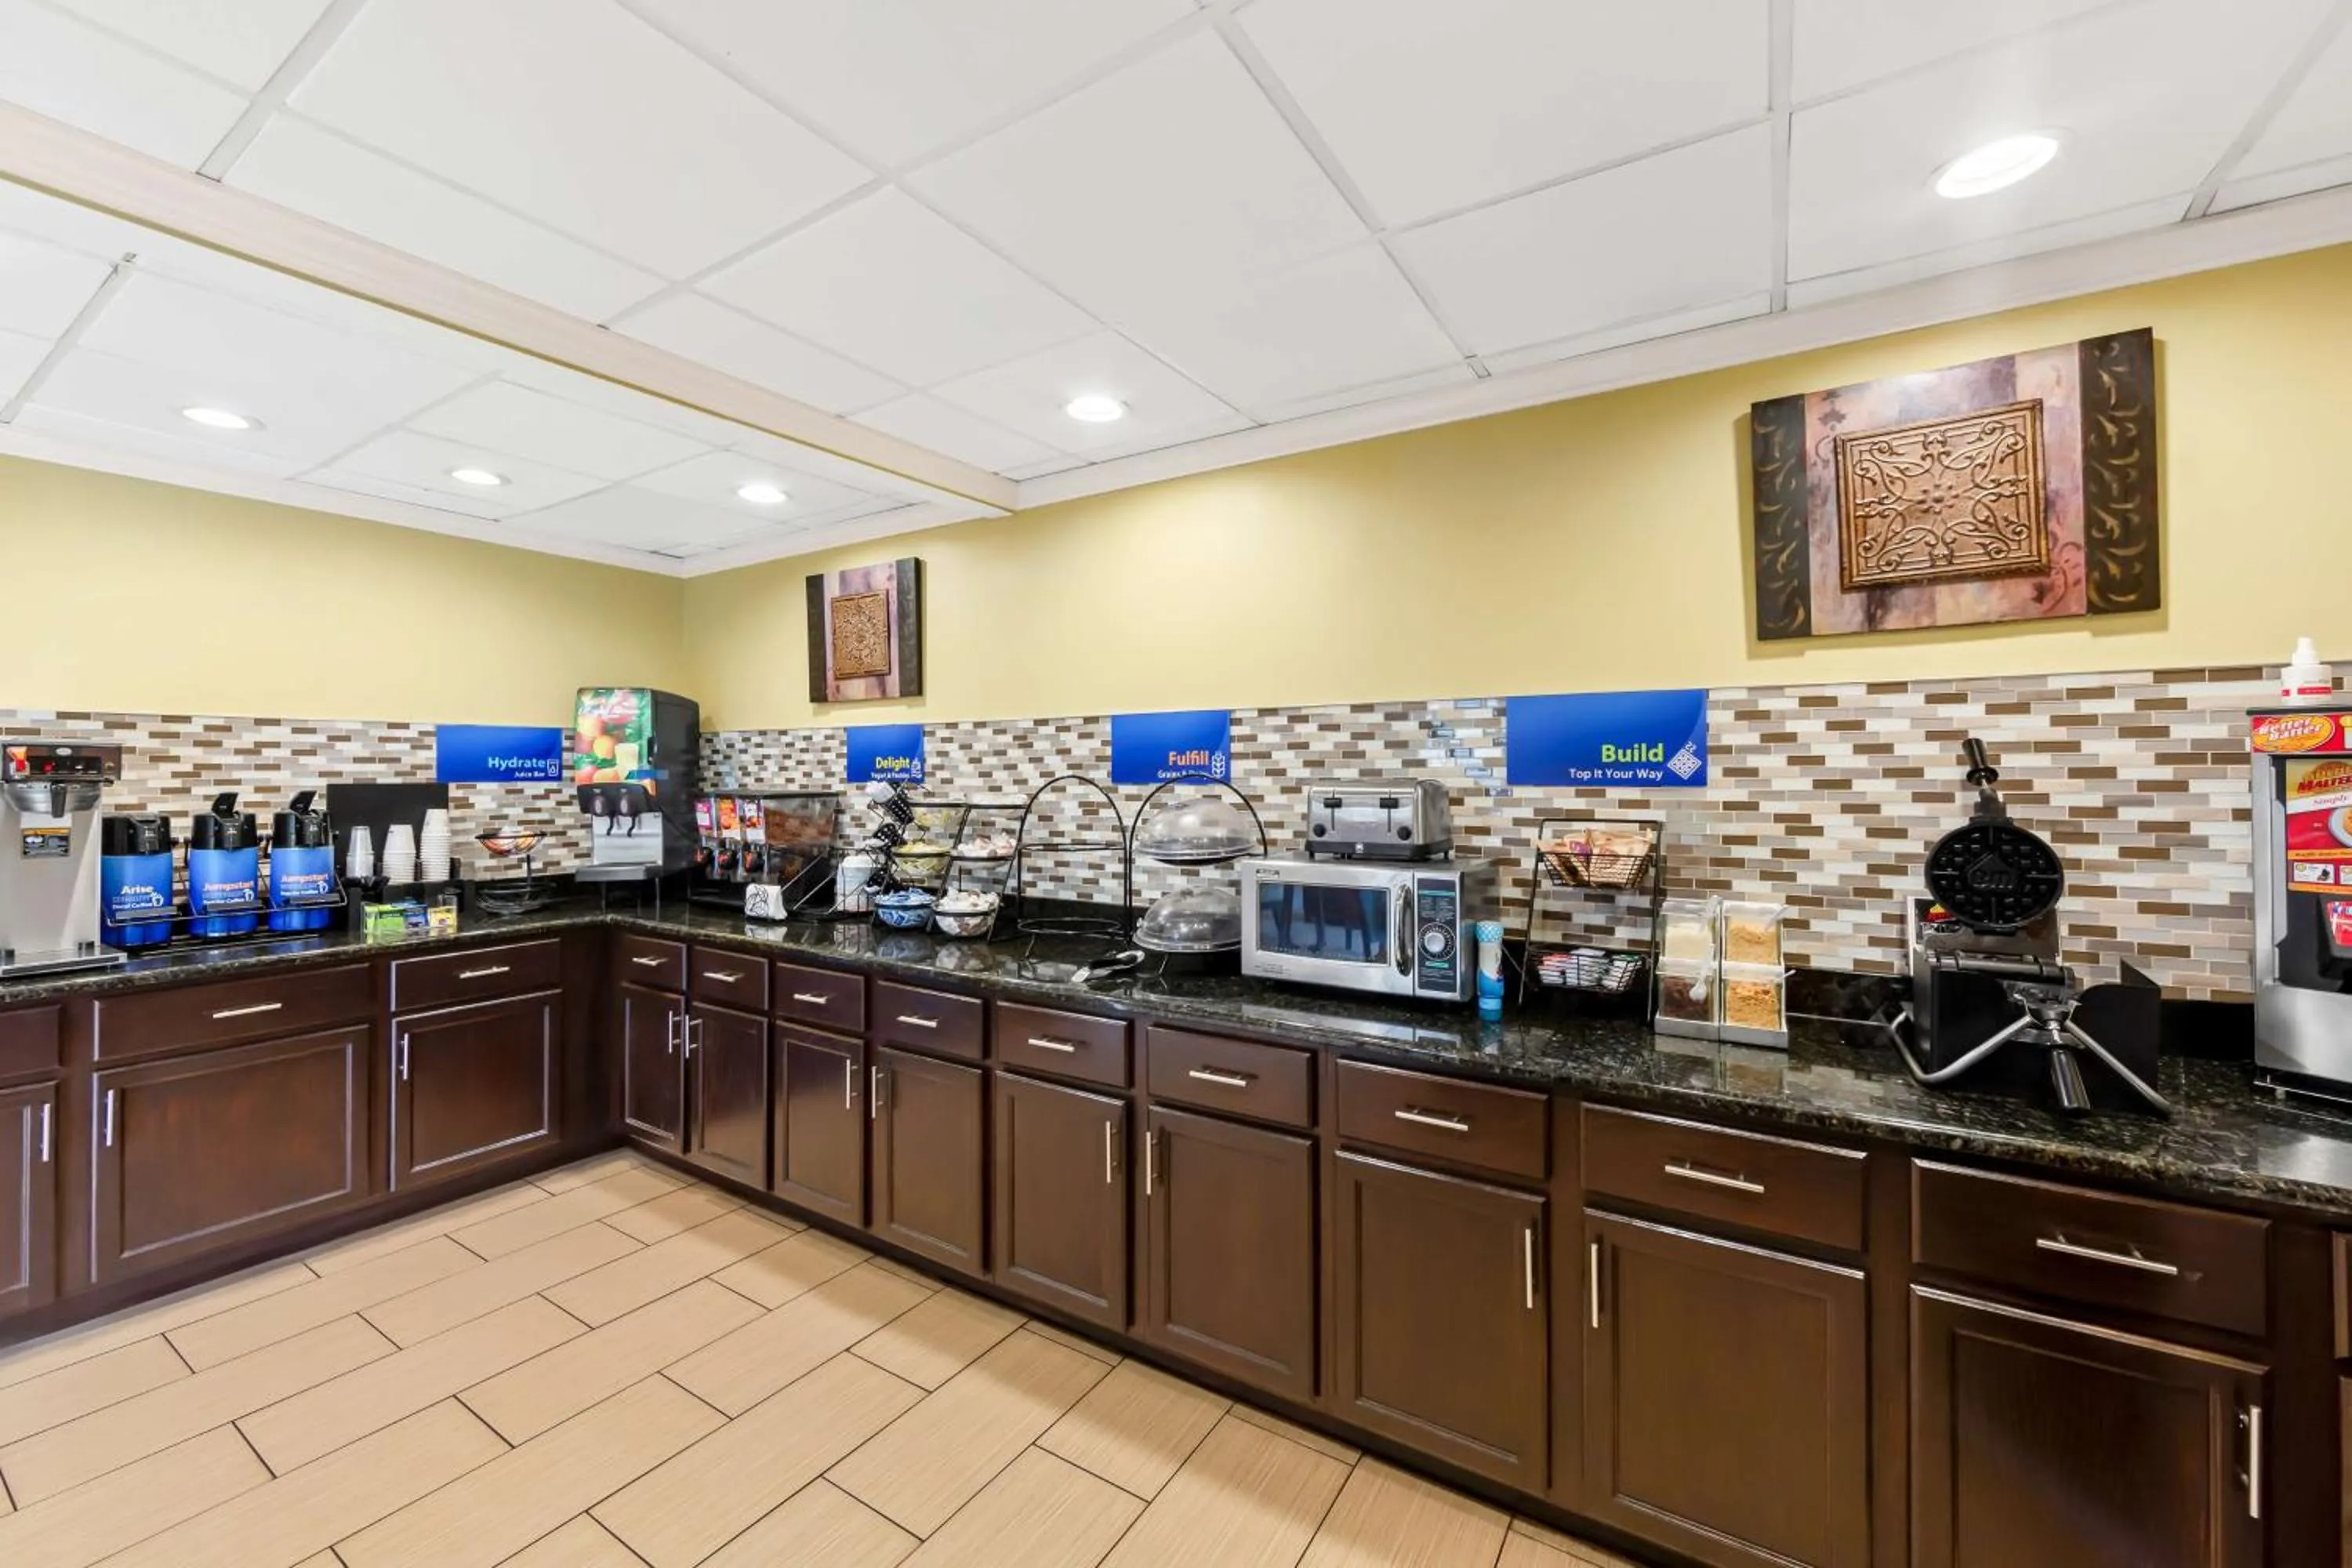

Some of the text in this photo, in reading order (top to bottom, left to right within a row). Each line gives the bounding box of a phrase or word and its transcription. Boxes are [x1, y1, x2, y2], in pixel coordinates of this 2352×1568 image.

[1169, 750, 1209, 766] Fulfill
[1602, 743, 1664, 763] Build
[488, 756, 546, 771] Hydrate
[876, 756, 910, 772] Delight
[1570, 768, 1663, 781] Top It Your Way
[121, 884, 154, 894] Arise
[203, 880, 254, 891] Jumpstart
